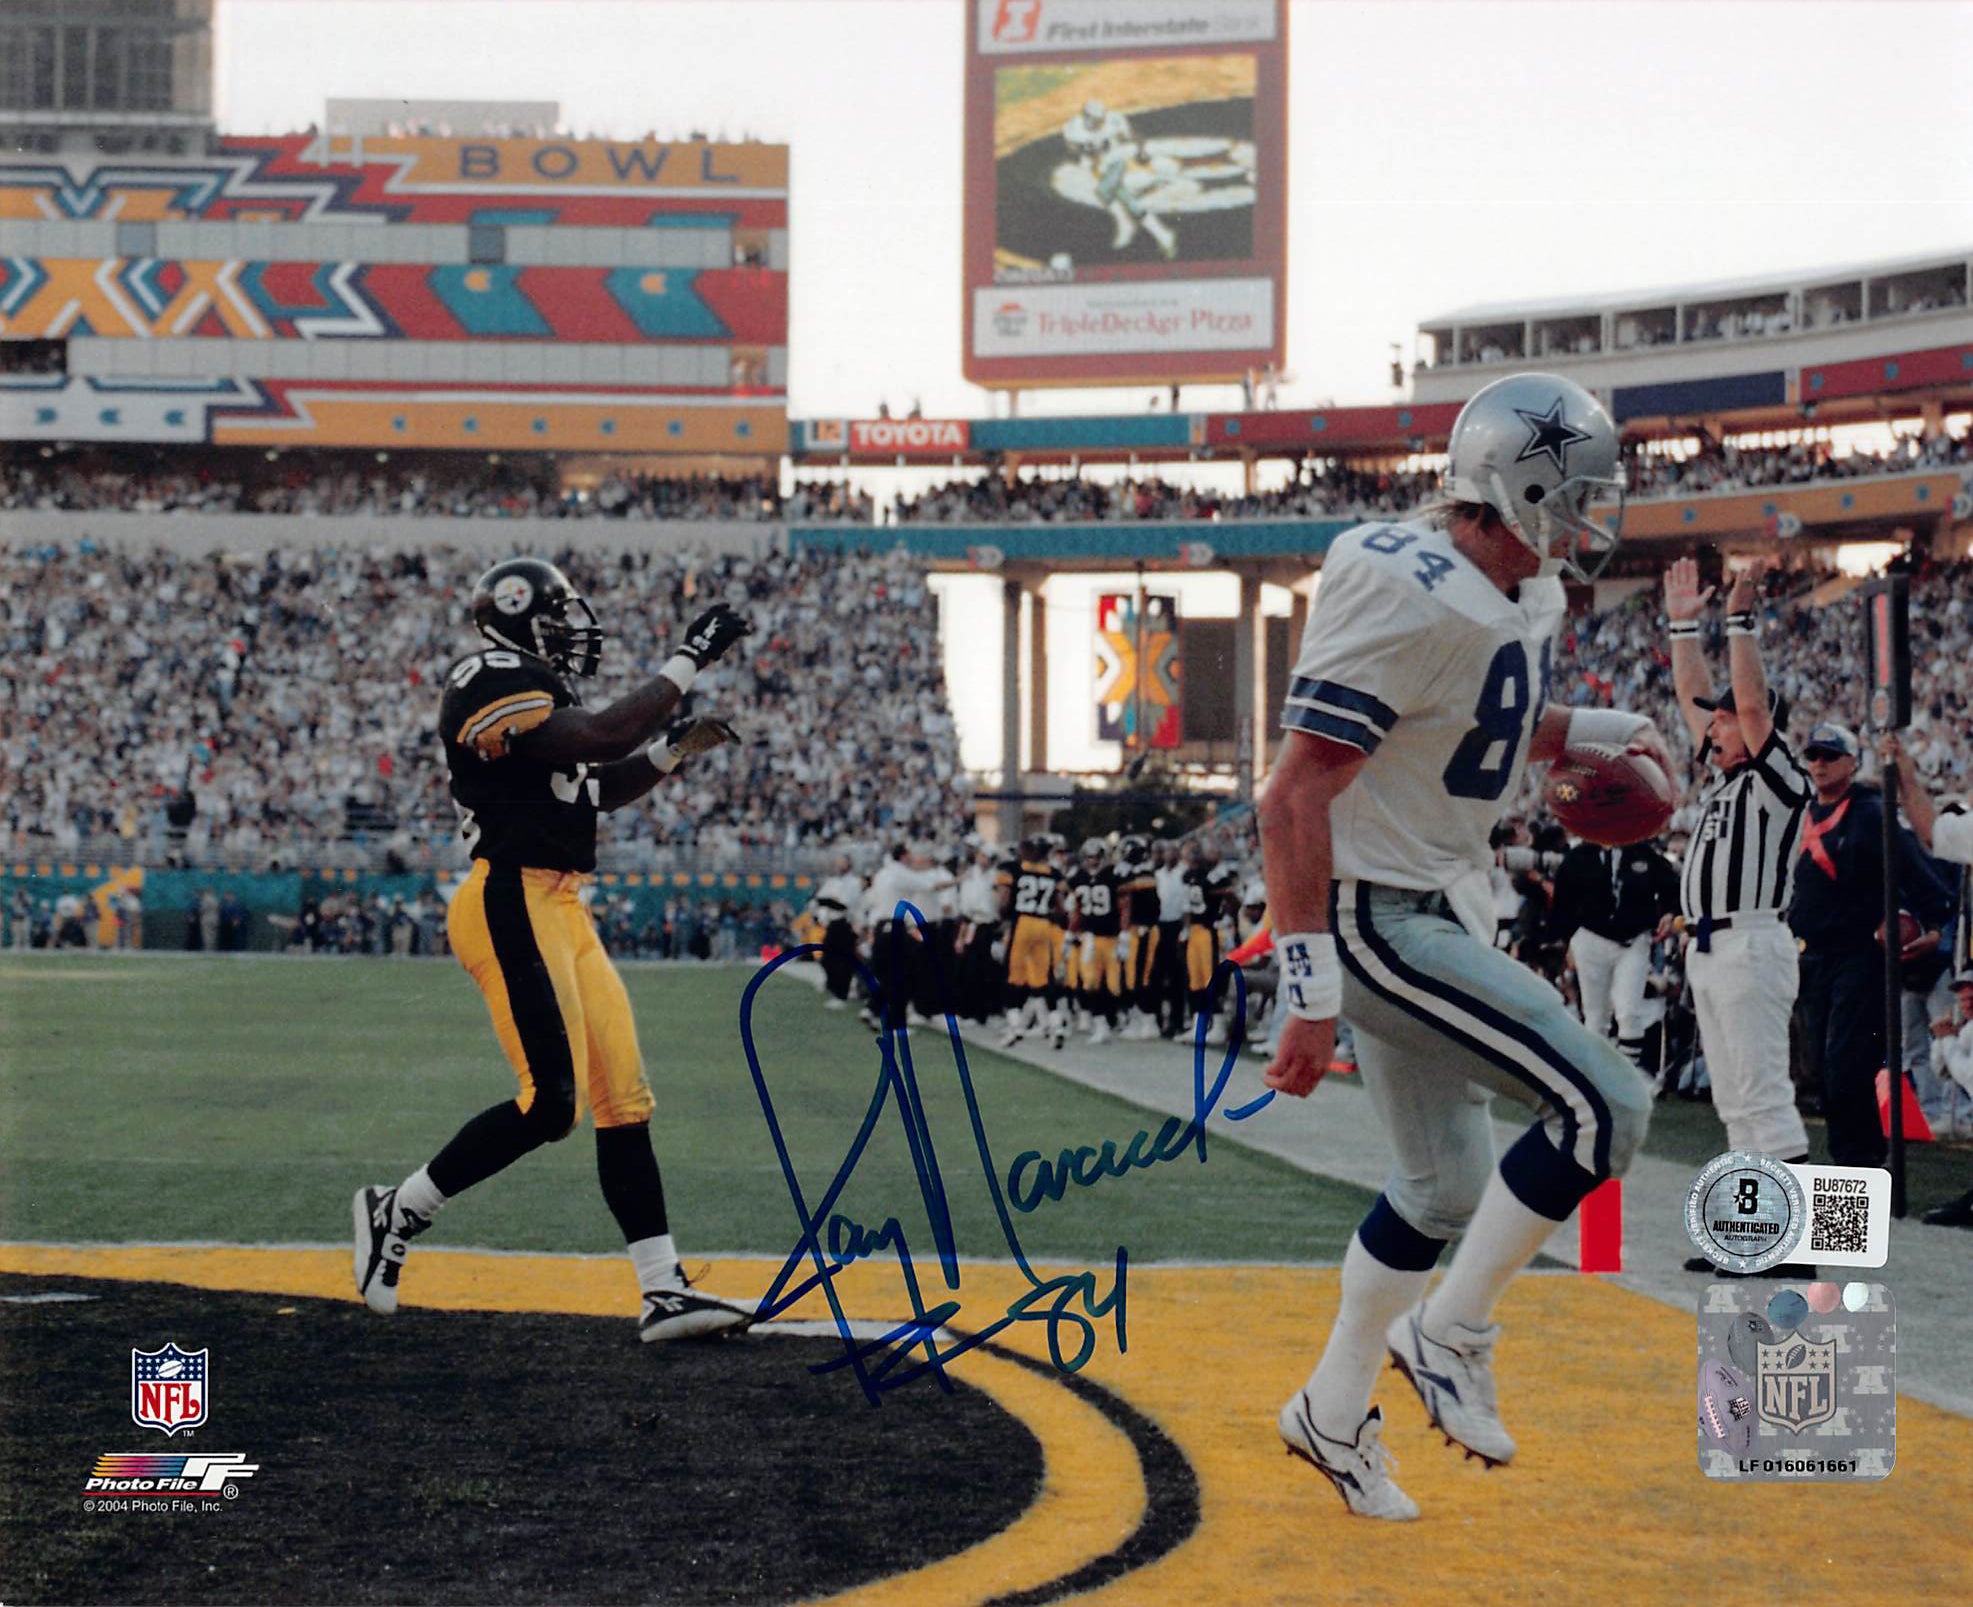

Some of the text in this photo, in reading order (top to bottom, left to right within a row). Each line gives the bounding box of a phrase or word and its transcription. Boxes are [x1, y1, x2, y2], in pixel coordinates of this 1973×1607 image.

[459, 145, 740, 184] BOWL
[856, 422, 963, 447] TOYOTA
[1362, 525, 1456, 592] 84
[1015, 875, 1057, 914] 27
[1813, 1178, 1867, 1194] BU87672
[1713, 1220, 1780, 1235] AUTHENTICATED
[1764, 1375, 1828, 1420] NFL
[1739, 1460, 1857, 1472] LF 016061661
